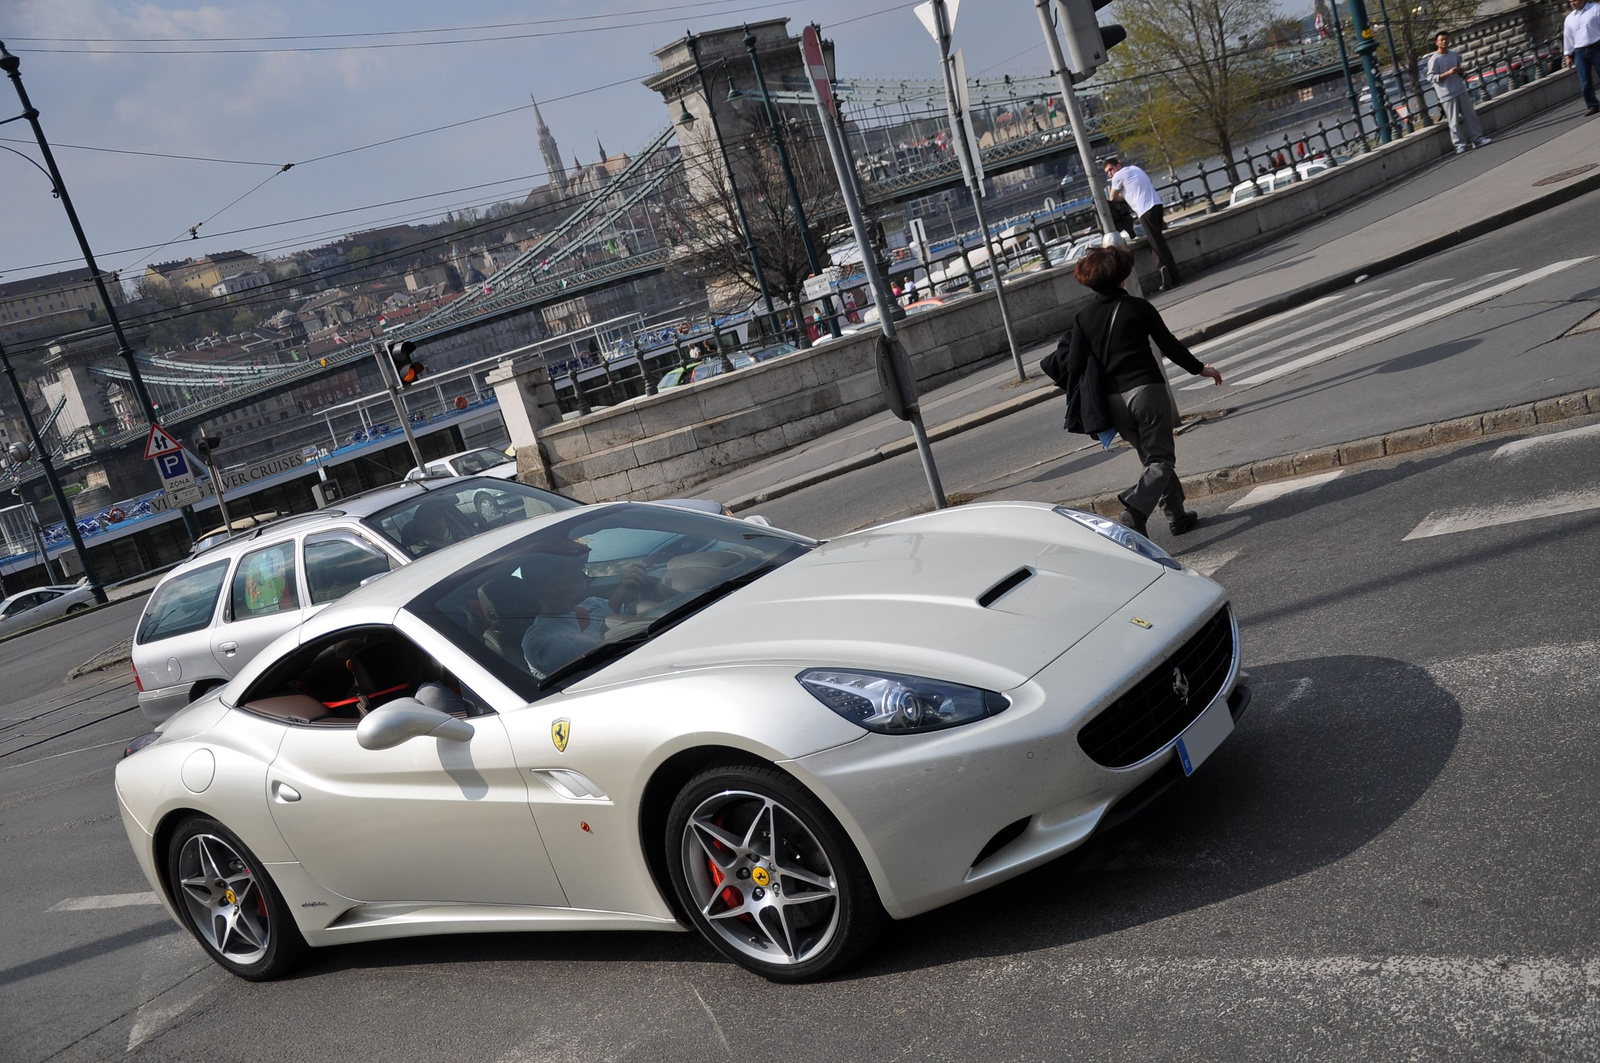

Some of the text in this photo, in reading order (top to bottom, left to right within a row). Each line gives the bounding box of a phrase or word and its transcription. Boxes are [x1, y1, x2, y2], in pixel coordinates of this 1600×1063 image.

[163, 455, 179, 474] P
[207, 473, 249, 494] RVER
[250, 453, 303, 480] CRUISES
